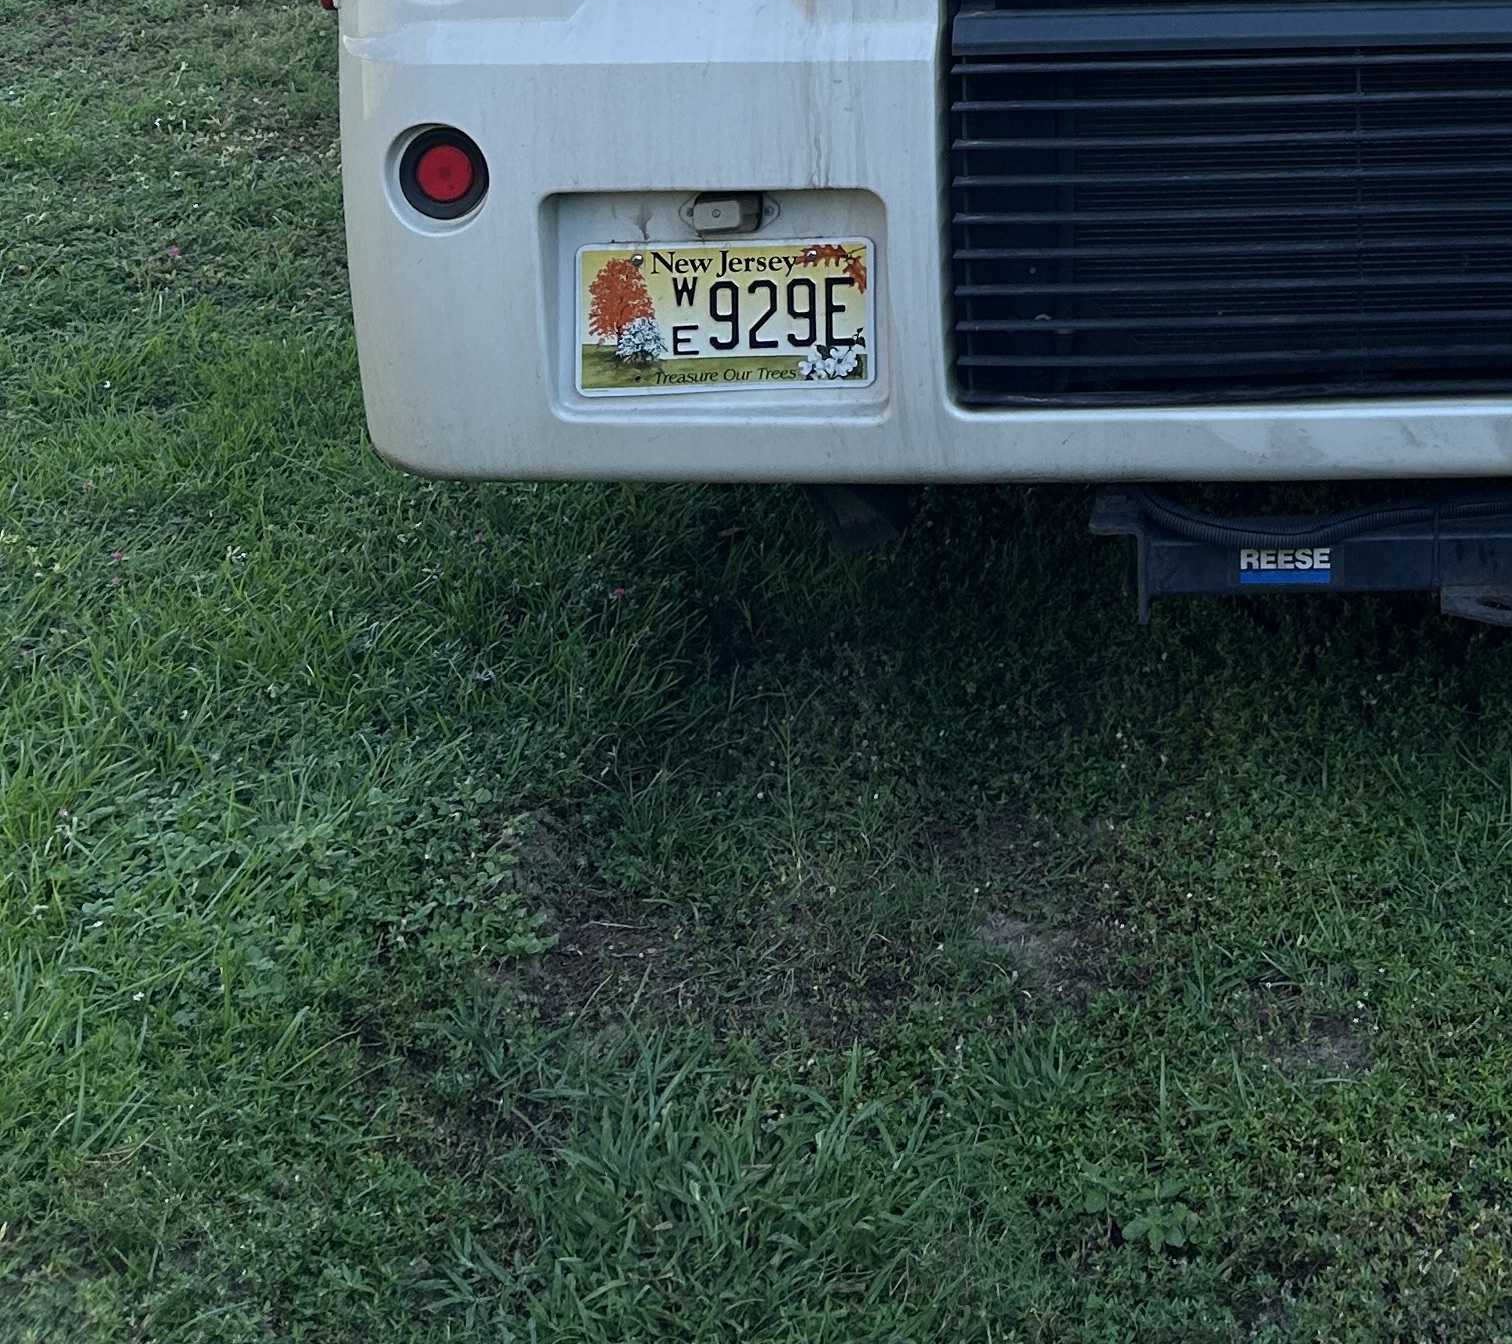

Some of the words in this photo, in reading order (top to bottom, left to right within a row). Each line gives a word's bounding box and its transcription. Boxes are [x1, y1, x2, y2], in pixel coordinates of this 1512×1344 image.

[651, 251, 713, 275] New
[716, 250, 798, 277] Jersey
[655, 369, 718, 385] Treasure
[723, 368, 752, 381] Our
[757, 366, 797, 380] Trees
[1240, 548, 1331, 570] REESE
